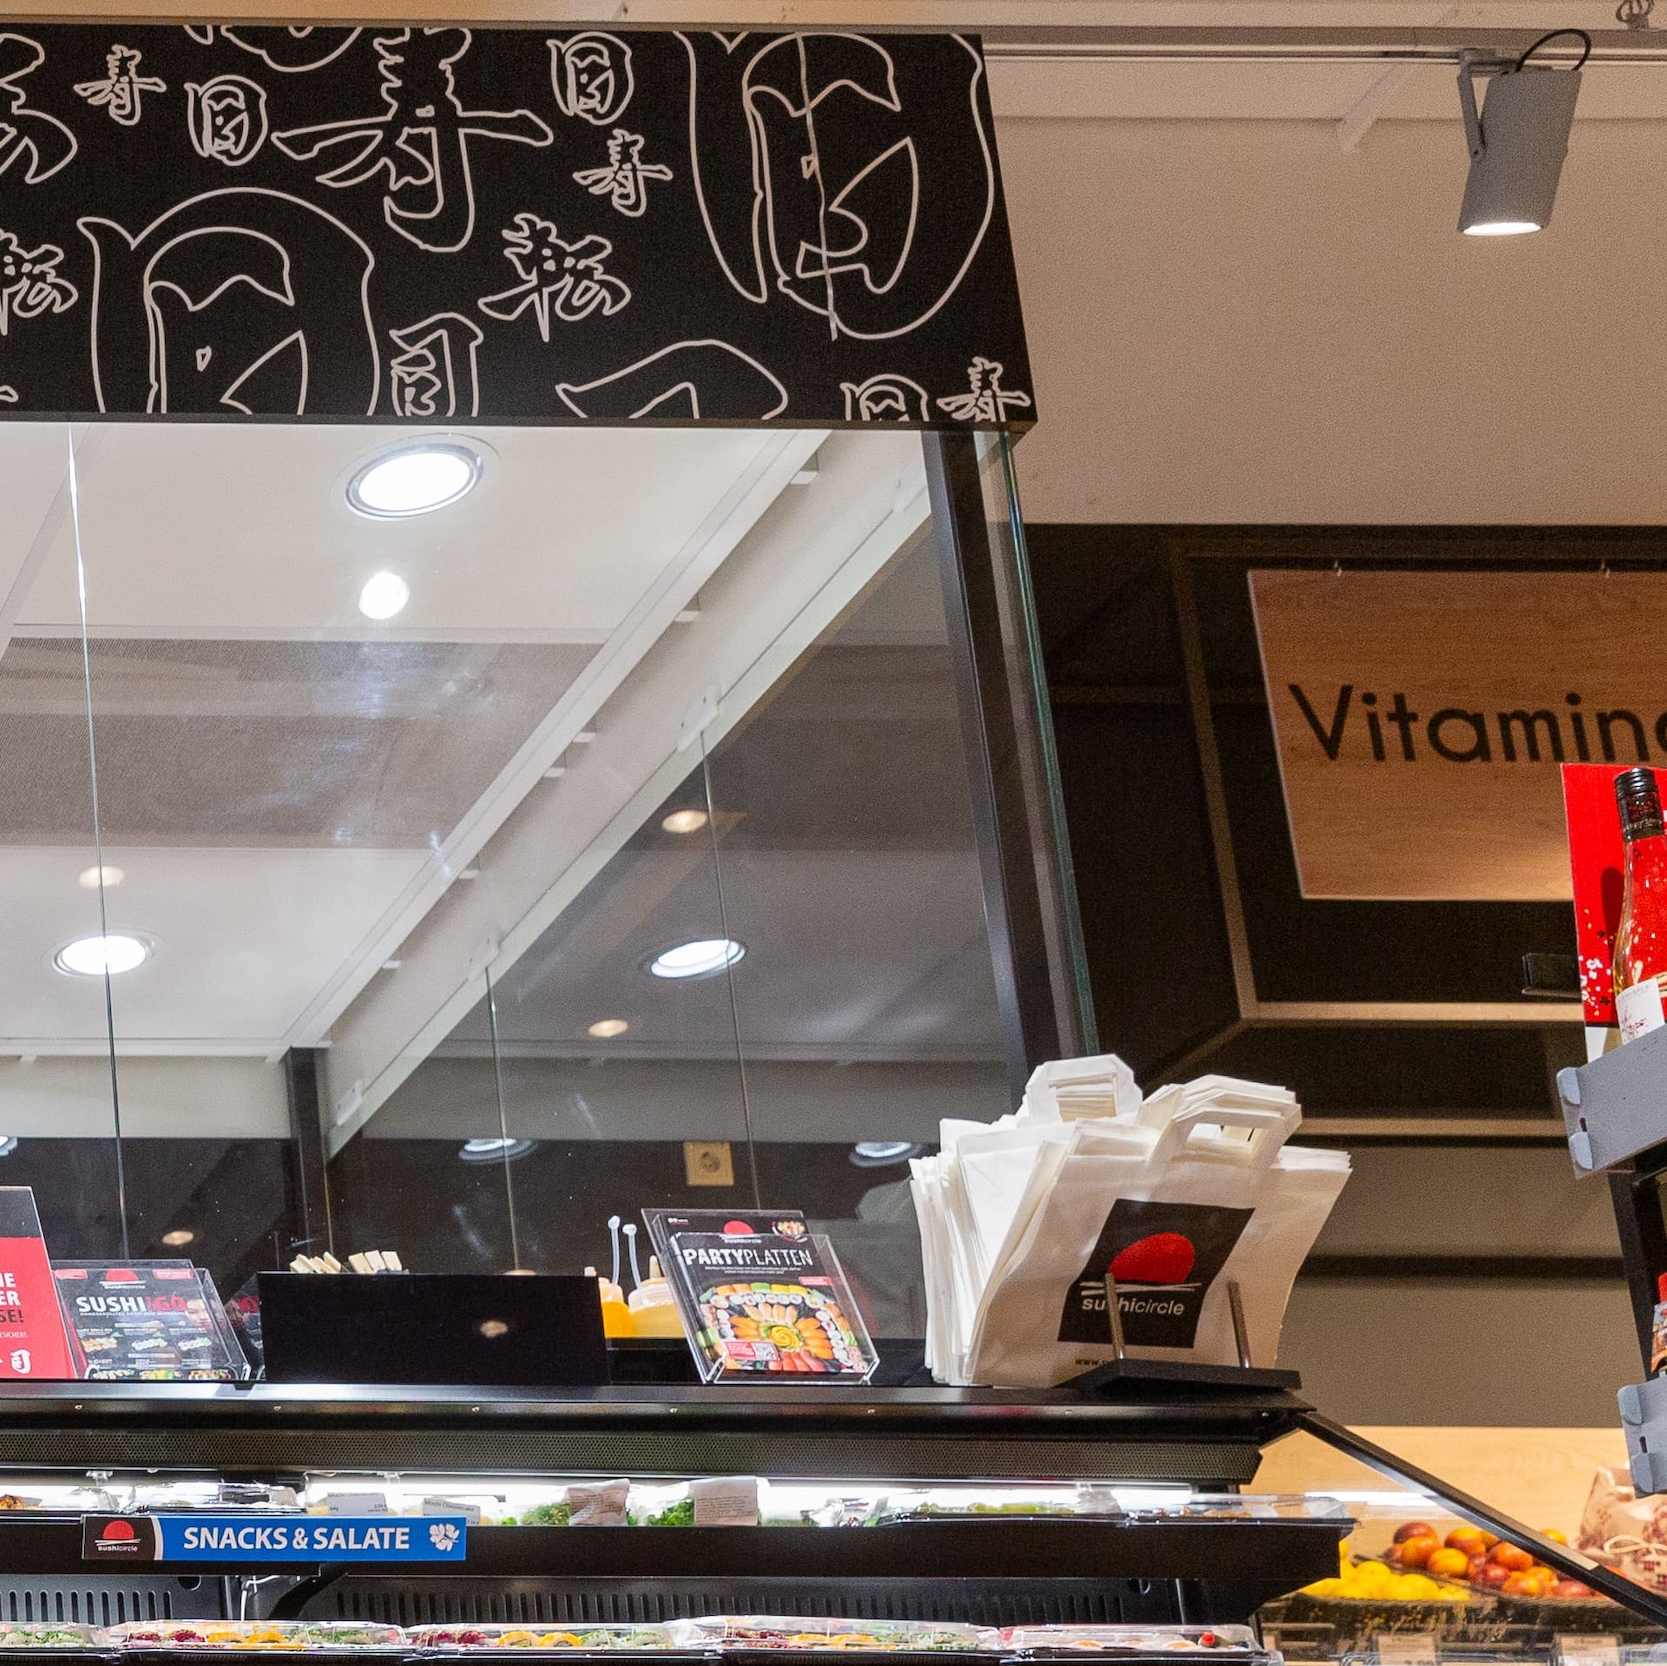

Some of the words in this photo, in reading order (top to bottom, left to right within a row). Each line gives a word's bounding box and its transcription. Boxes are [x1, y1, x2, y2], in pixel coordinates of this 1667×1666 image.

[1288, 683, 1667, 764] Vitamin
[682, 1248, 814, 1266] PARTYPLATTEN
[1081, 1296, 1185, 1316] suhicircle
[182, 1526, 289, 1551] SNACKS
[292, 1527, 309, 1550] &
[313, 1526, 410, 1551] SALATE
